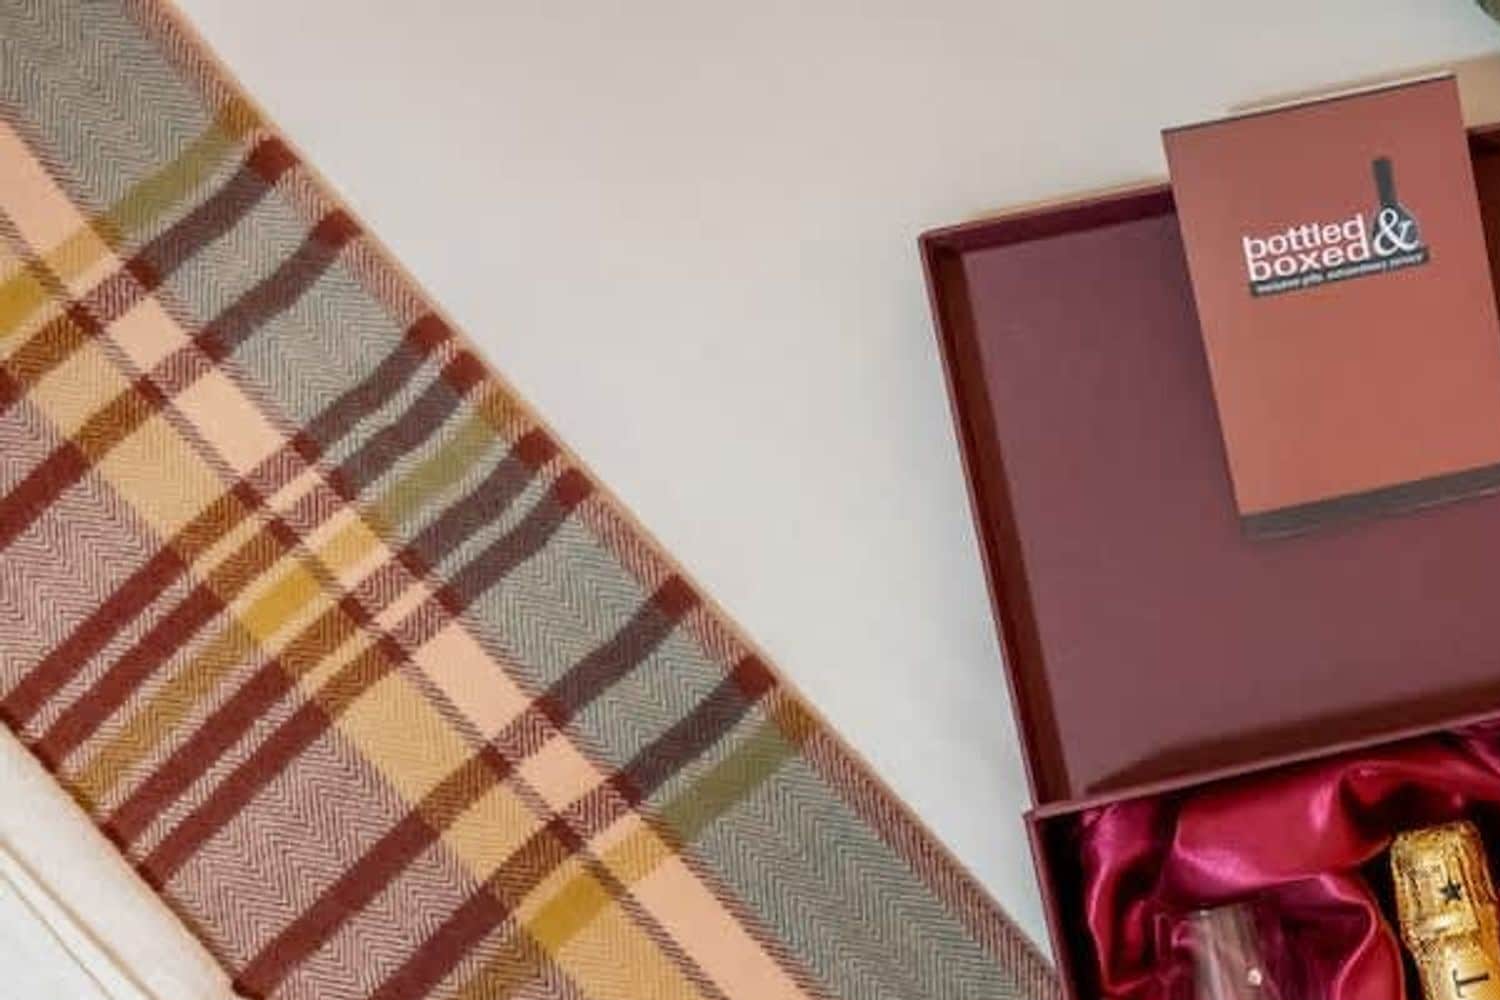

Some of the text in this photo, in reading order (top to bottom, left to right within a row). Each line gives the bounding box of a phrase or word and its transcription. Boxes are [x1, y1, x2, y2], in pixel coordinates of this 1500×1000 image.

[1243, 208, 1419, 260] bottled &
[1248, 238, 1371, 282] boxed
